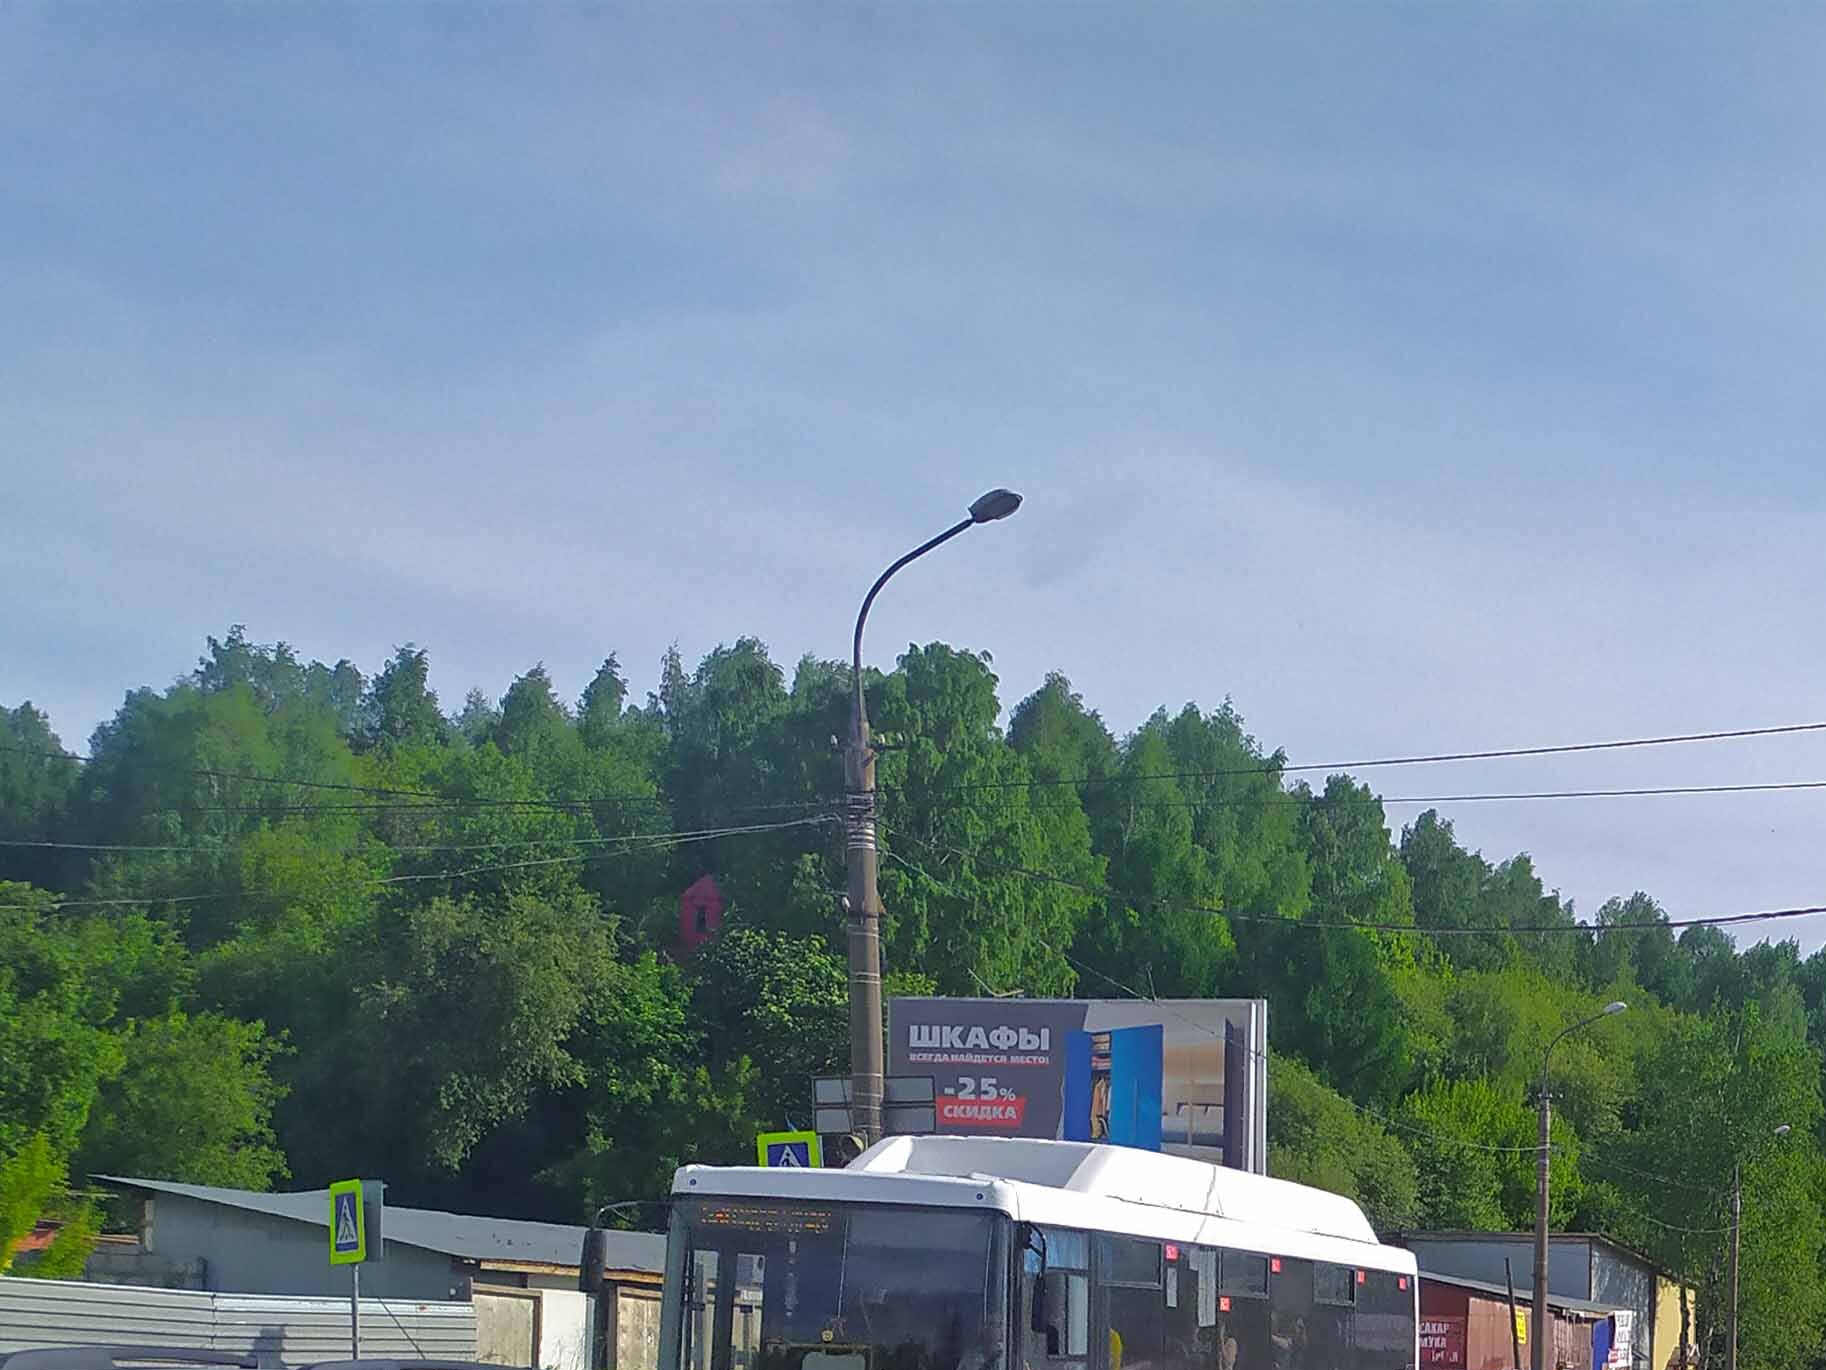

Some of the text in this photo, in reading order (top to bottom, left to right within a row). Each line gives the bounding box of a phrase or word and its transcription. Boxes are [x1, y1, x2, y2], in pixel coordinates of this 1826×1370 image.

[909, 1025, 1050, 1050] ШКАФЫ
[909, 1053, 949, 1063] ВСЕГДА
[944, 1077, 1016, 1101] -25%
[943, 1105, 1016, 1120] СКИДКА
